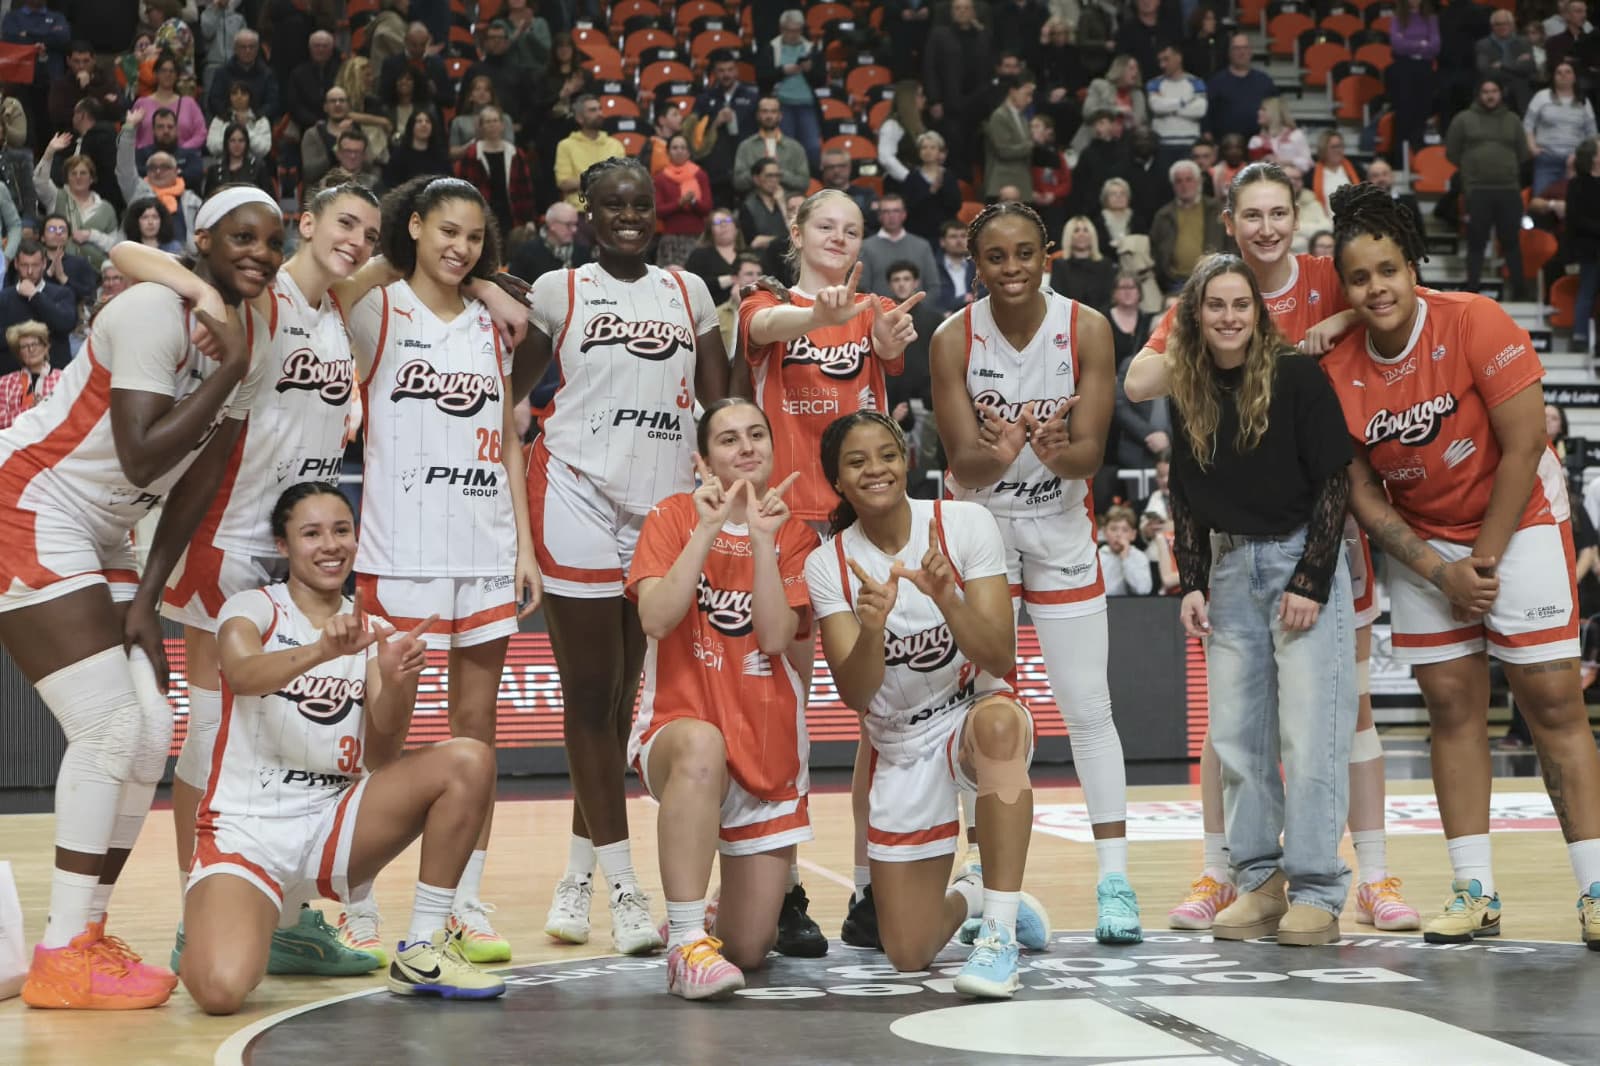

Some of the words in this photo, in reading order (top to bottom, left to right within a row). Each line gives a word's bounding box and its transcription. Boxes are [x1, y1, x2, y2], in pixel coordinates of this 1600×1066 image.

[580, 312, 694, 361] Bourges
[781, 334, 872, 380] Bourge
[275, 347, 355, 406] Bourg
[613, 409, 682, 432] PHM
[1364, 391, 1459, 447] Bourges
[476, 427, 503, 464] 26
[647, 430, 683, 441] GROUP
[425, 466, 498, 487] PHM
[994, 476, 1062, 498] PHM
[1389, 466, 1428, 481] ERCPI
[462, 487, 499, 498] GROUP
[1025, 489, 1063, 506] GROUP
[272, 674, 367, 726] ourge
[337, 735, 363, 774] 32
[1244, 933, 1538, 954] Clture
[733, 966, 1426, 1000] Boures
